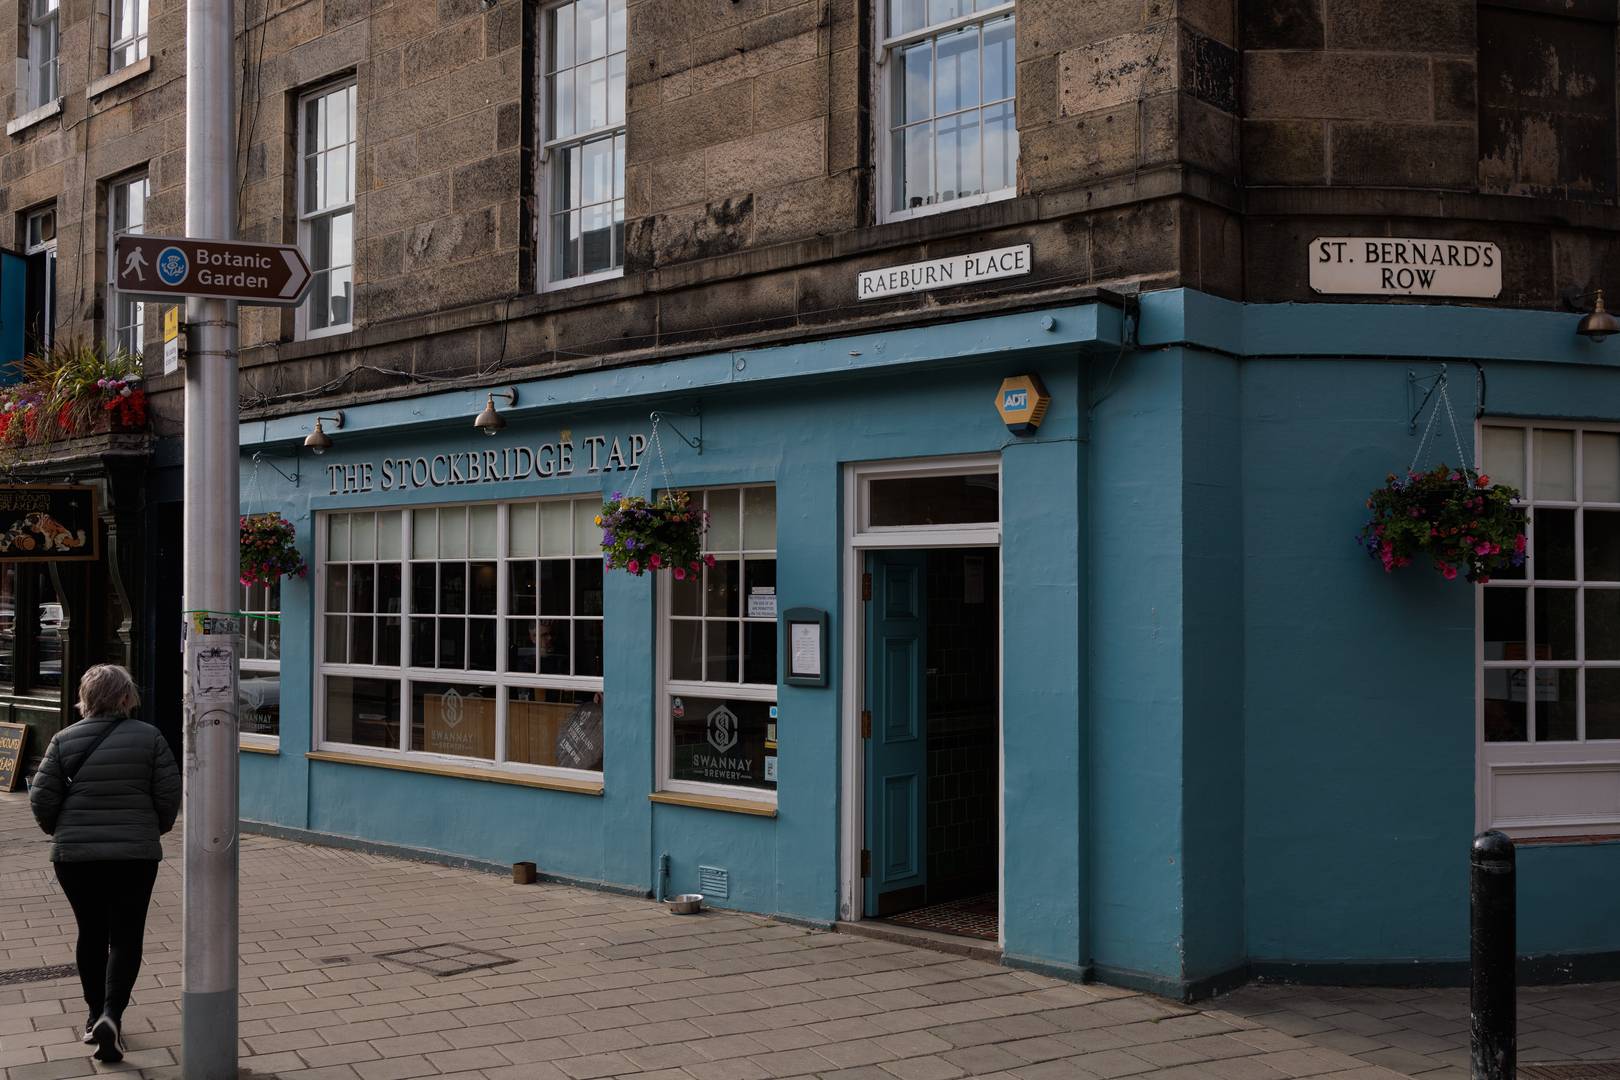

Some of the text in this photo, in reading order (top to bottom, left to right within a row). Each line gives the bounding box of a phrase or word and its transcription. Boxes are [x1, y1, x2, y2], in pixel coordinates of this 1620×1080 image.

[196, 249, 272, 269] Botanic
[1319, 241, 1494, 267] ST. BERNARD'S
[198, 269, 268, 289] Garden
[863, 251, 1025, 294] RAEBURN PLACE
[1381, 267, 1436, 289] ROW
[1004, 392, 1027, 407] ADT
[327, 433, 648, 495] THE STOCKBRIDGE TAP
[431, 730, 474, 743] SWANNAY
[692, 754, 753, 771] SWANNAY
[704, 768, 741, 780] BREWERY
